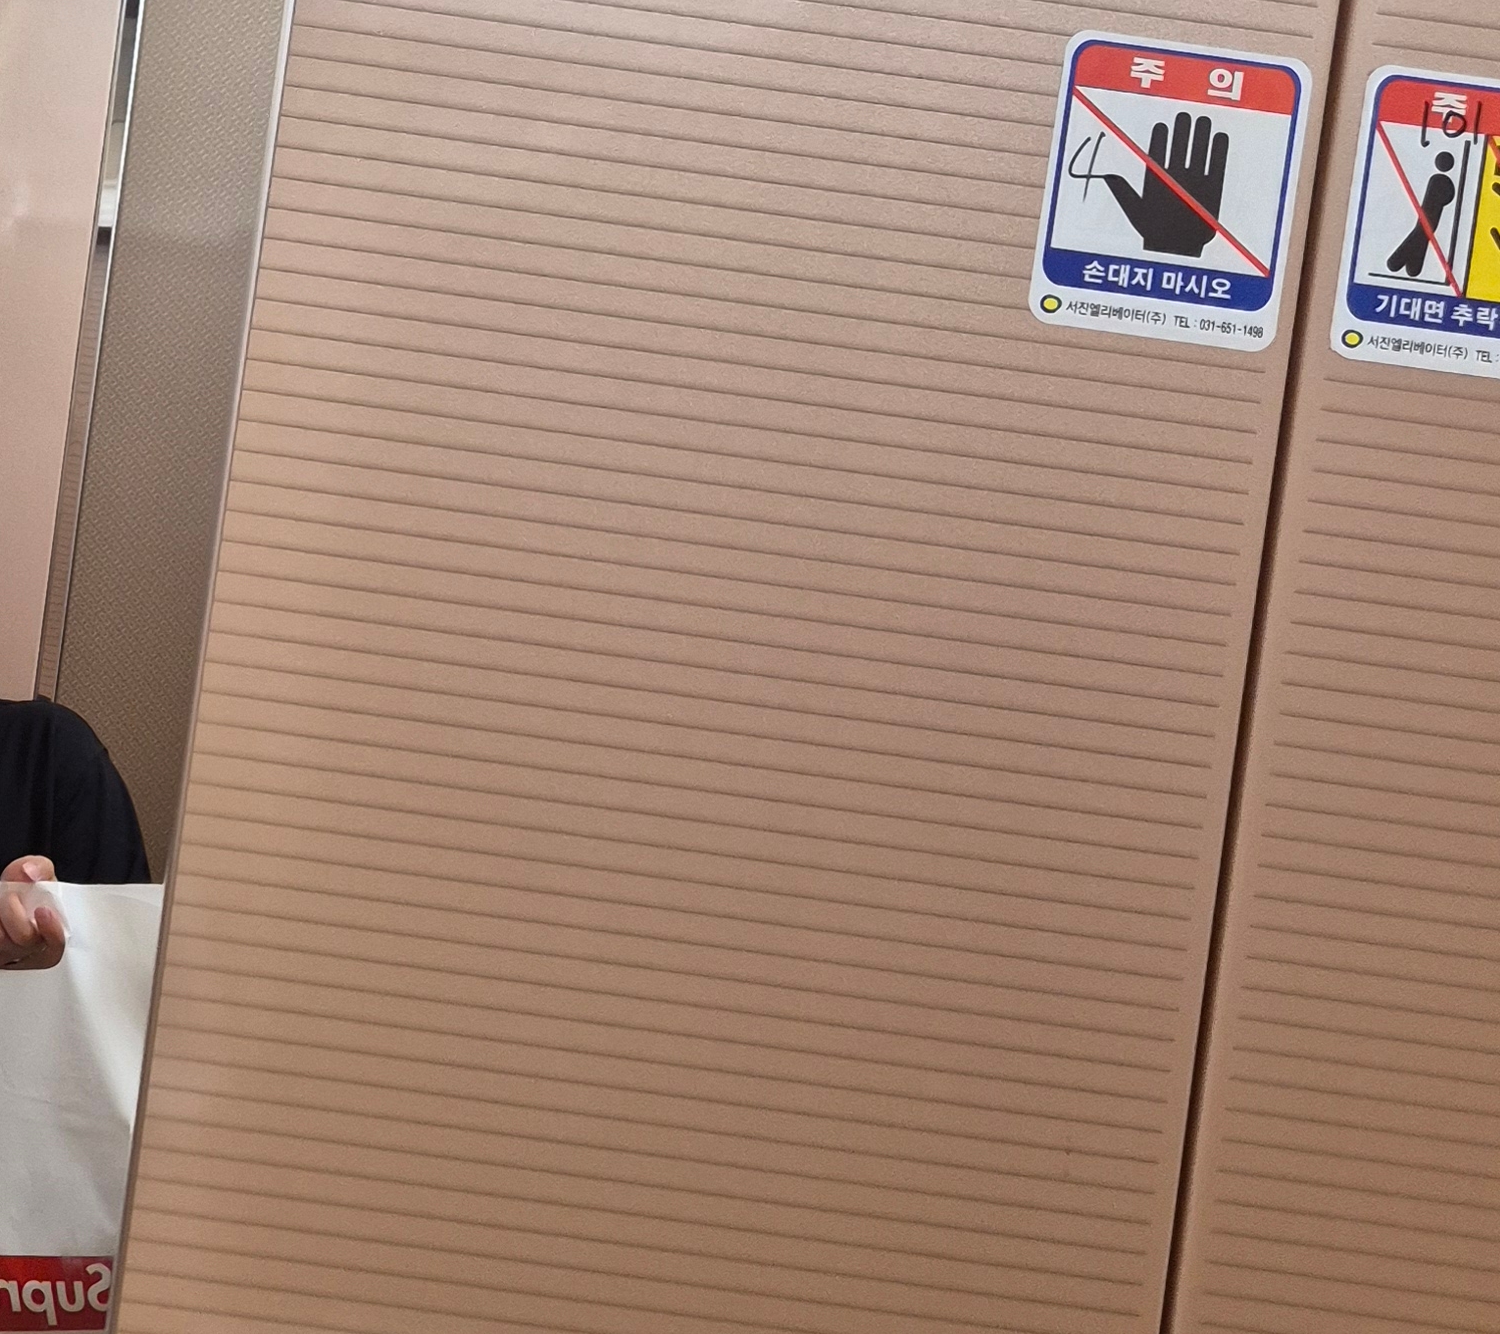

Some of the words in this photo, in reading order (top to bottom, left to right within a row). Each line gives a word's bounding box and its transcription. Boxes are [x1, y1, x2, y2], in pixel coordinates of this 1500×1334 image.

[1130, 56, 1165, 89] 주
[1206, 70, 1245, 102] 의
[1082, 259, 1153, 291] 손대지
[1161, 270, 1233, 301] 마시오
[1374, 293, 1445, 325] 기대면
